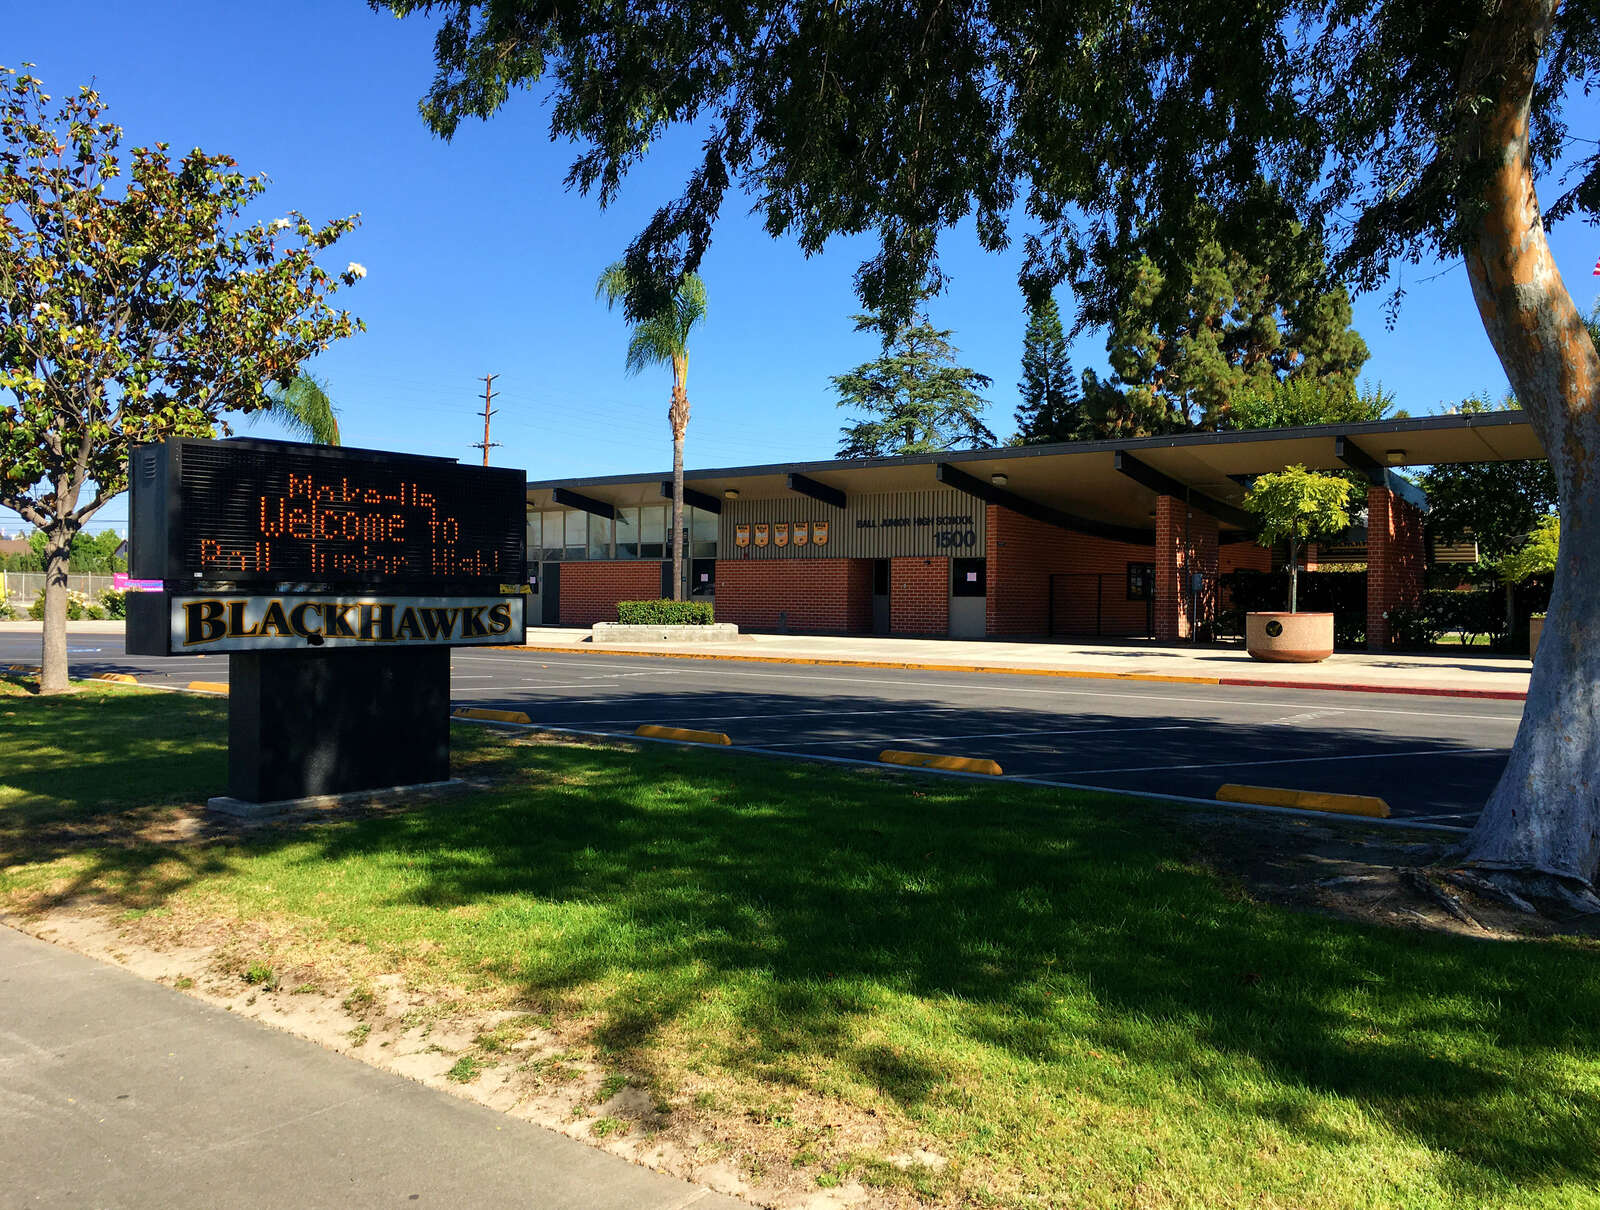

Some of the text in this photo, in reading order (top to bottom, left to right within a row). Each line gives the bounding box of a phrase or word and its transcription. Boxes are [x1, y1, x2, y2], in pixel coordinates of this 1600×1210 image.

[260, 496, 405, 543] Welcome
[856, 515, 974, 528] BALL JUNIOR HIGH SCHOOL
[932, 530, 976, 548] 1500
[183, 600, 513, 647] BLACKHAWKS
